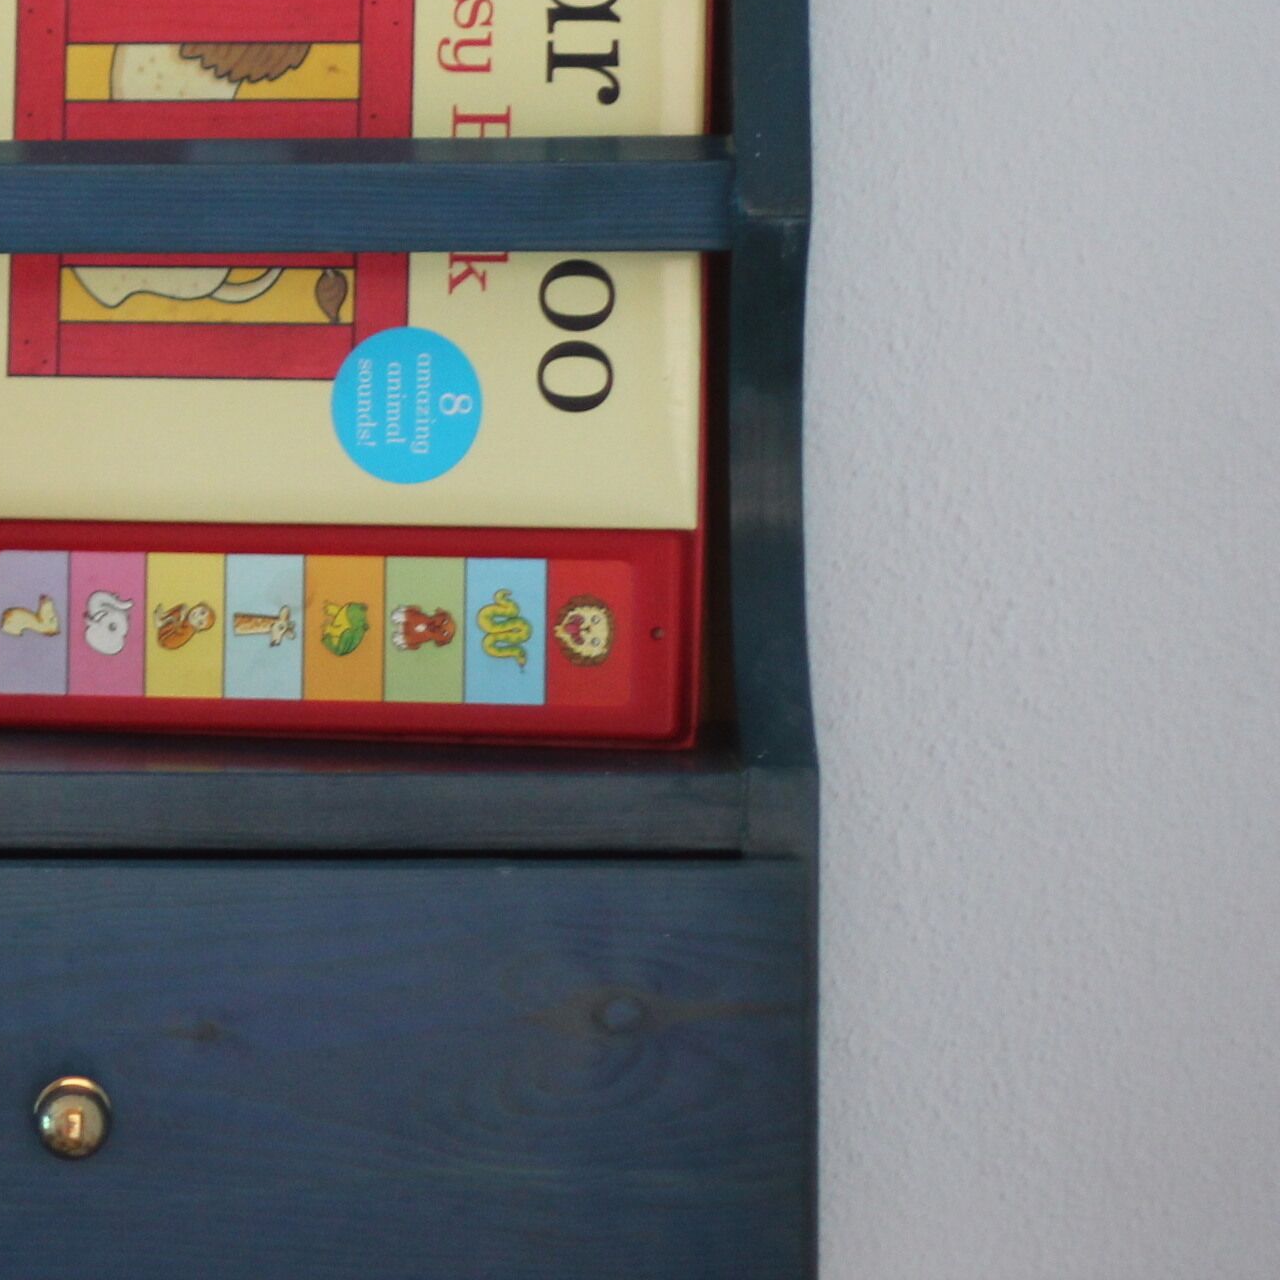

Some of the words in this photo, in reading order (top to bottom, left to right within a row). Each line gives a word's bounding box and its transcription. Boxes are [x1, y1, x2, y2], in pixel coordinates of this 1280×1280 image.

[357, 358, 378, 448] sounds!
[385, 362, 406, 445] animal
[411, 352, 437, 455] amazing
[439, 392, 472, 416] 8
